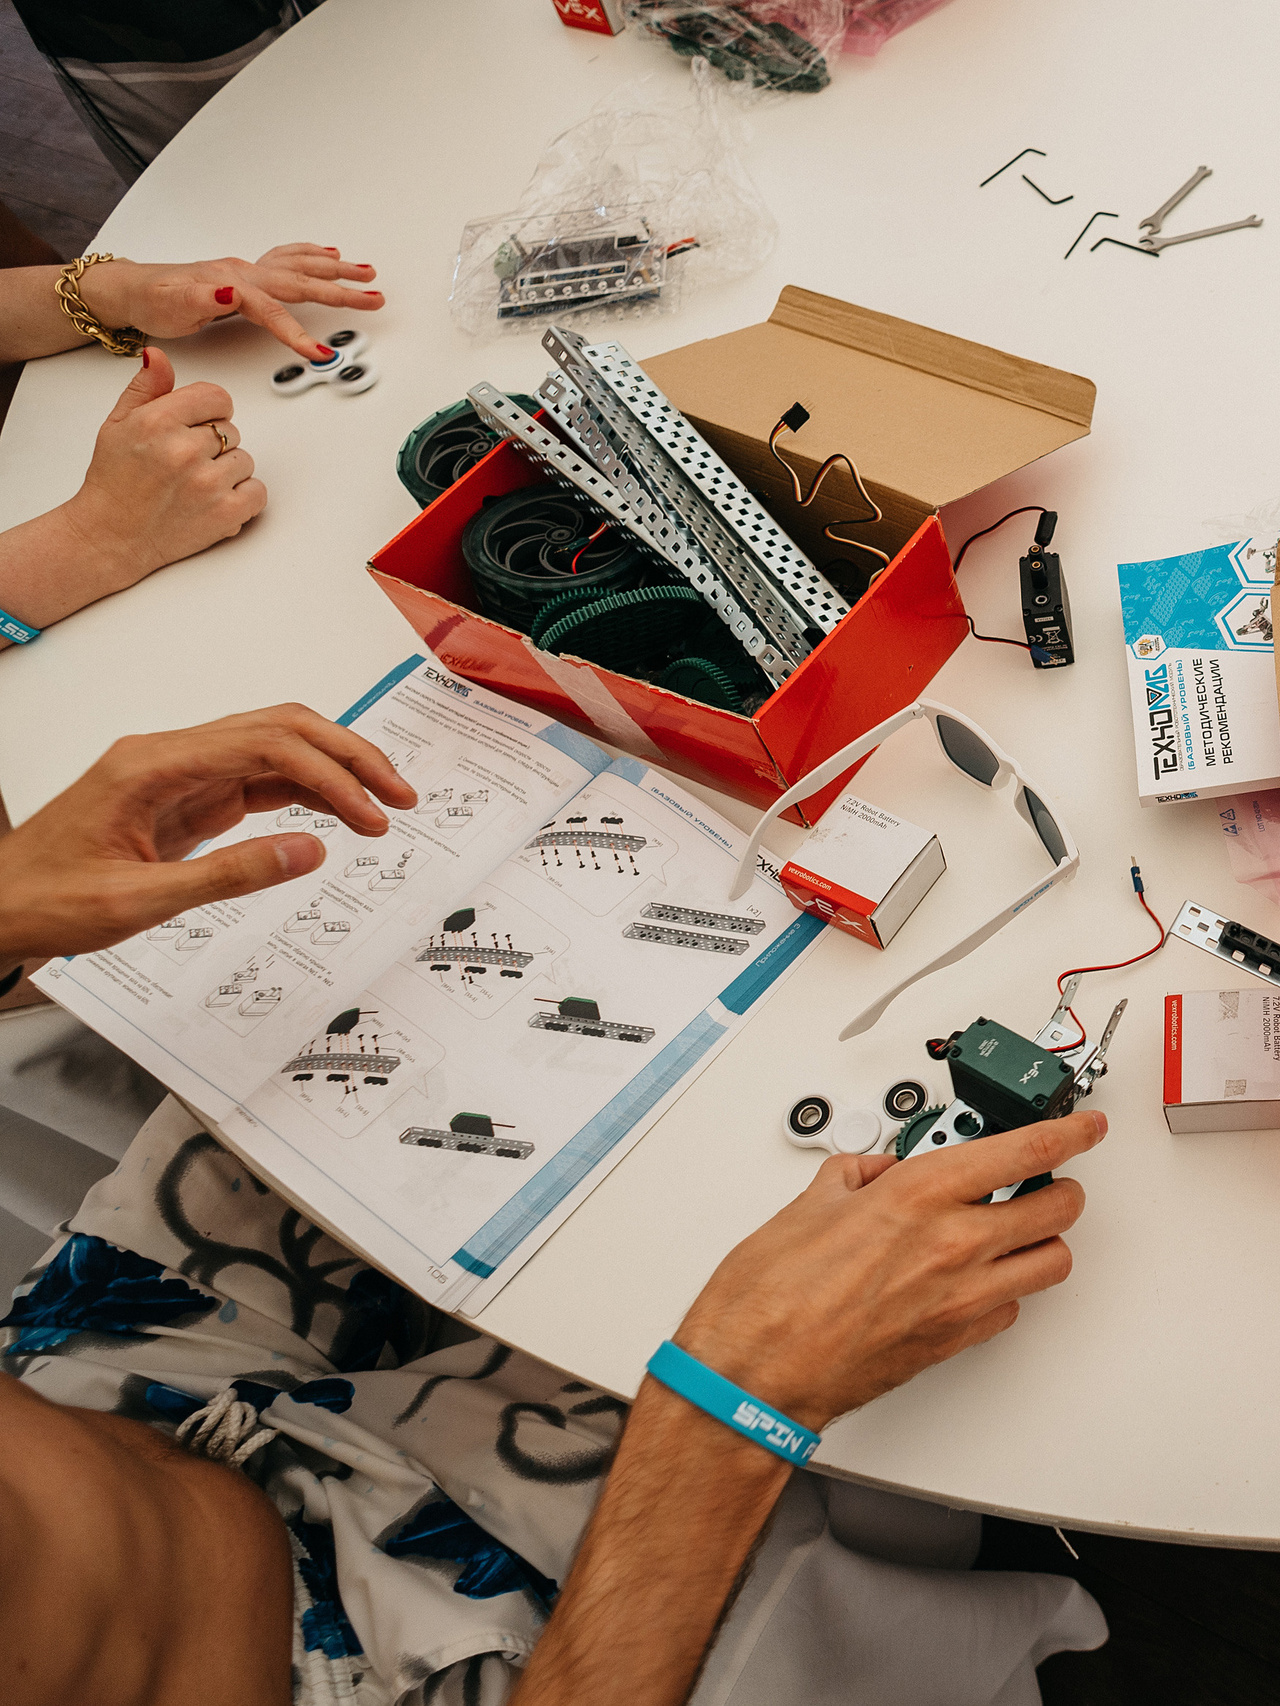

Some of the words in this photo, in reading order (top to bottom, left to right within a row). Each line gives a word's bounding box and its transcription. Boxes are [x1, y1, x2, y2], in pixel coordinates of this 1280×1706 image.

[553, 0, 602, 22] VEX
[1175, 659, 1188, 710] УРОВЕНЬ)
[1192, 657, 1217, 767] МЕТОДИЧЕСКИЕ
[1208, 658, 1234, 764] РЕКОМЕНДАЦИИ
[1181, 713, 1195, 769] (БАЗОВЫЙ
[650, 785, 693, 818] (БАЗОВЫЙ
[693, 816, 733, 849] УРОВЕНЬ)
[840, 803, 858, 815] NiMH
[857, 811, 887, 829] 2000mAh
[846, 797, 861, 807] 7.2V
[860, 804, 878, 816] Robot
[877, 812, 900, 827] Battery
[788, 865, 832, 890] vexrobotics.com
[746, 904, 761, 917] [x2]
[787, 889, 866, 934] VEX
[755, 928, 796, 967] Приложение
[46, 966, 61, 978] 104
[1262, 996, 1270, 1015] NiMH
[1263, 1017, 1271, 1051] 2000mAh
[1273, 1035, 1280, 1061] Battery
[1018, 1061, 1043, 1084] VEX
[426, 1264, 448, 1284] 105
[731, 1400, 804, 1454] SPIN
